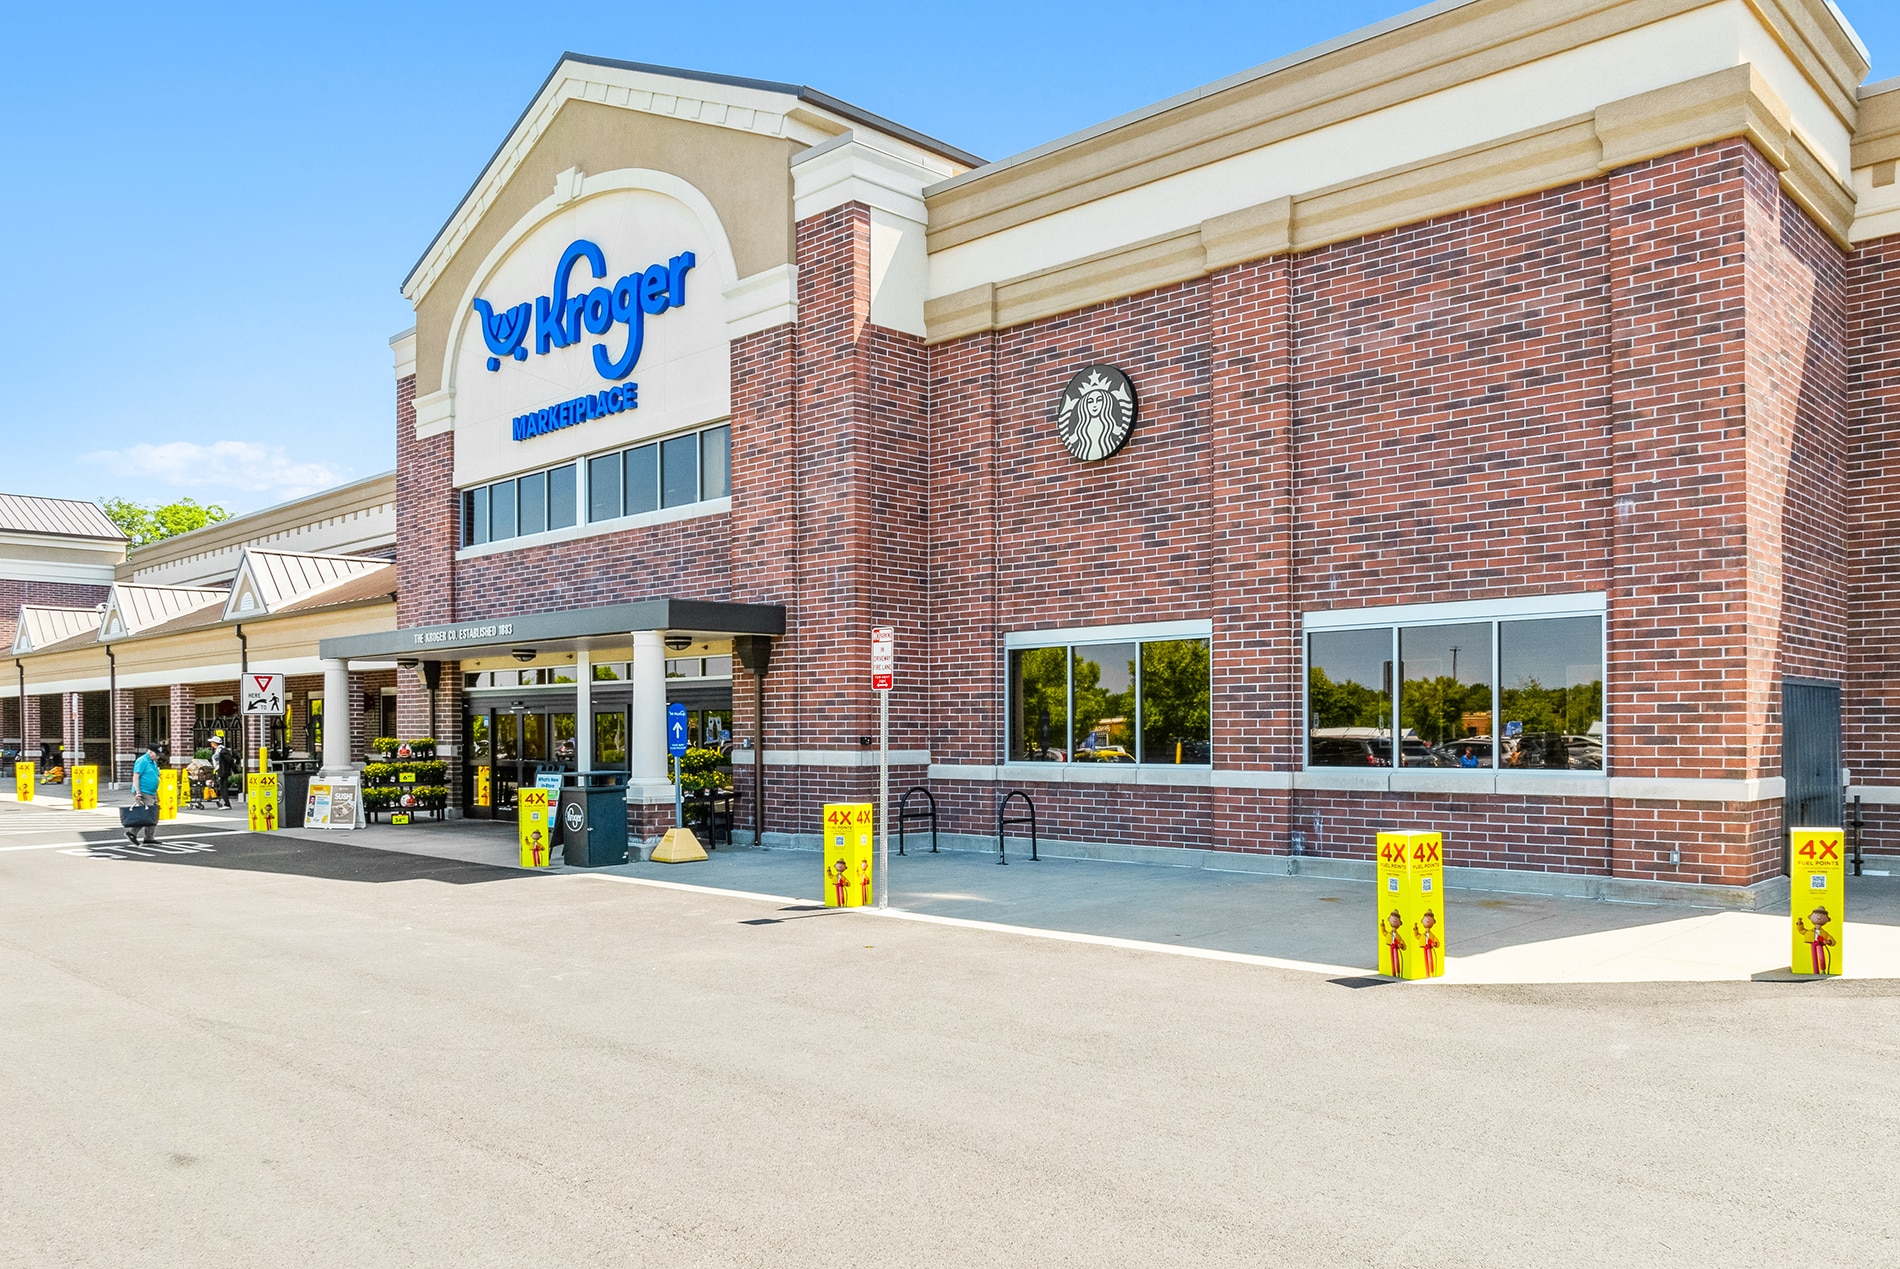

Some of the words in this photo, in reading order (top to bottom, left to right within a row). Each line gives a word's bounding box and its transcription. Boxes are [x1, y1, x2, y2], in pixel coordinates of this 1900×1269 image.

[535, 239, 695, 380] Kroger
[512, 382, 638, 441] MARKETPLACE
[414, 633, 424, 644] THE
[425, 630, 447, 643] KROGER
[459, 625, 497, 640] ESTABLISHED
[249, 776, 257, 785] 4X
[260, 776, 275, 785] 4X
[334, 792, 354, 800] SUSHI
[524, 792, 546, 805] 4X
[567, 807, 582, 828] Kroger
[827, 810, 852, 825] 4X
[856, 809, 871, 824] 4X
[56, 841, 218, 860] STOP
[1380, 842, 1406, 863] 4X
[1413, 841, 1439, 862] 4X
[1798, 839, 1839, 860] 4X
